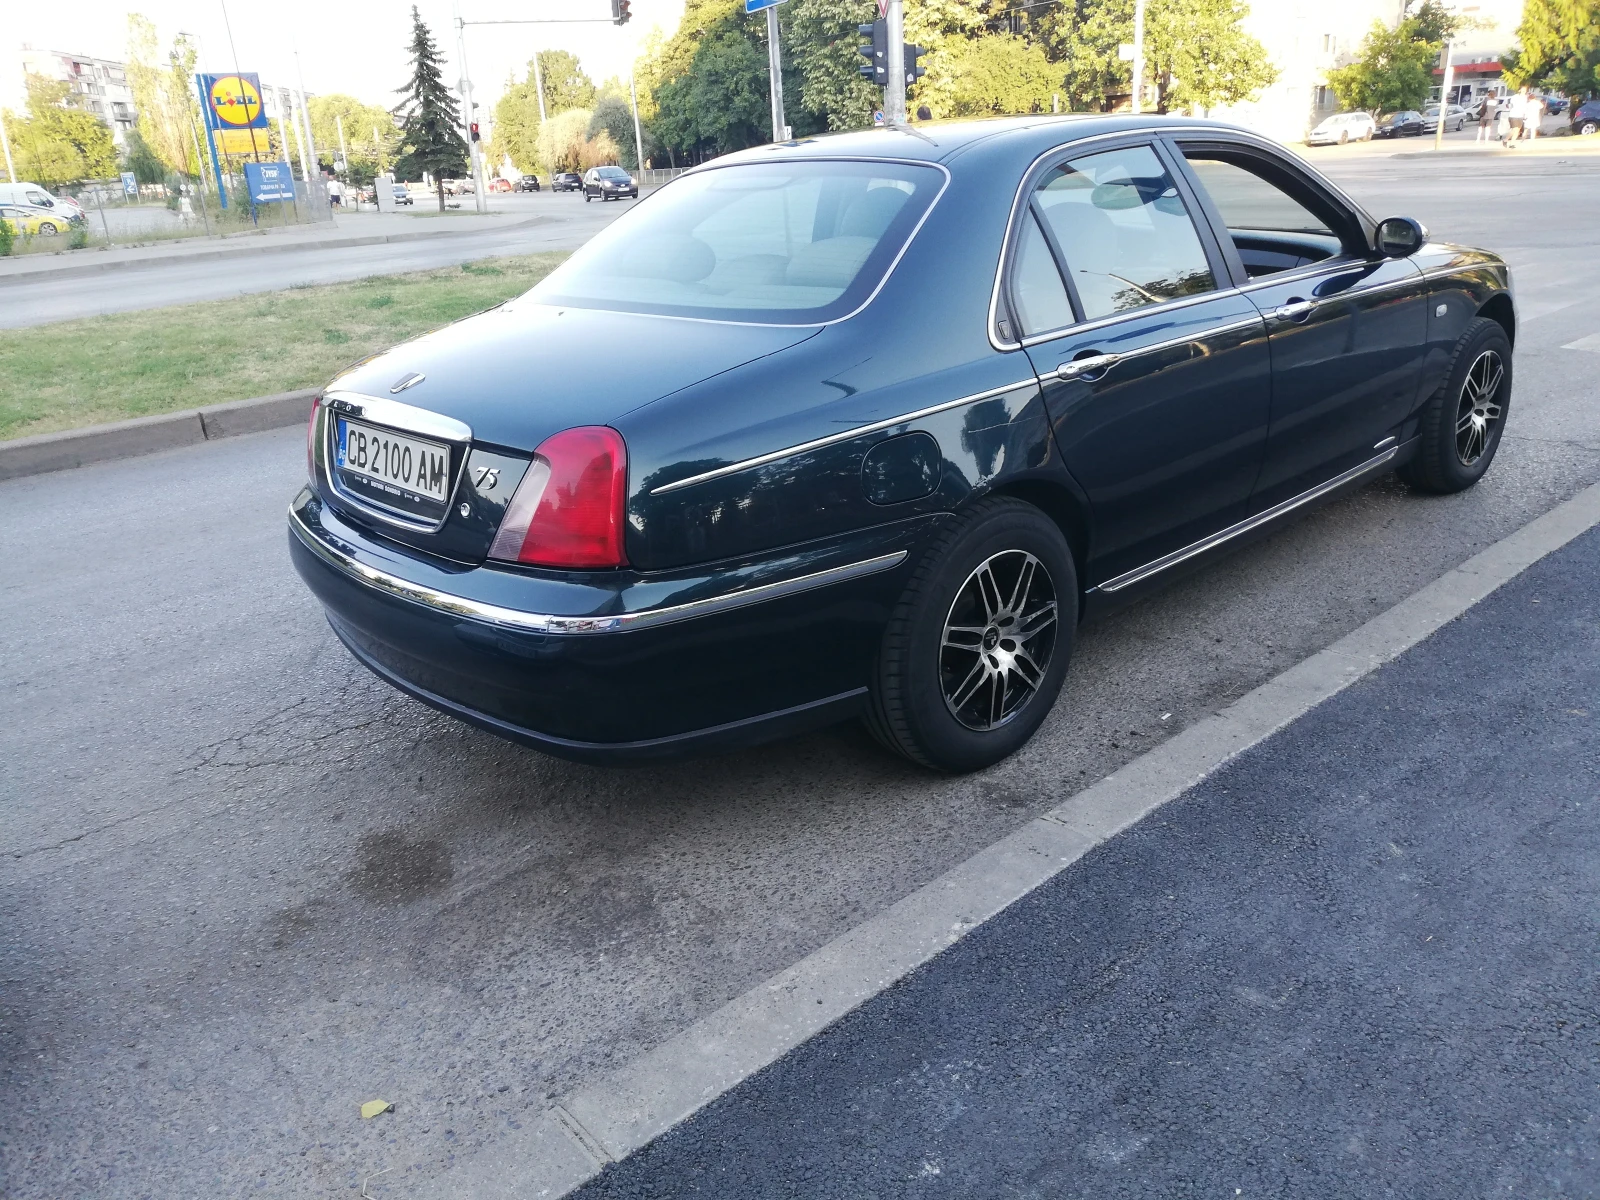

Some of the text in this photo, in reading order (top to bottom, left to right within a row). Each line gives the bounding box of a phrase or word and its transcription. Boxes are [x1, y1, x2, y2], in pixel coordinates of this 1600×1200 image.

[347, 429, 368, 468] CB
[370, 436, 412, 483] 2100
[415, 450, 444, 494] AM
[475, 466, 501, 490] 75
